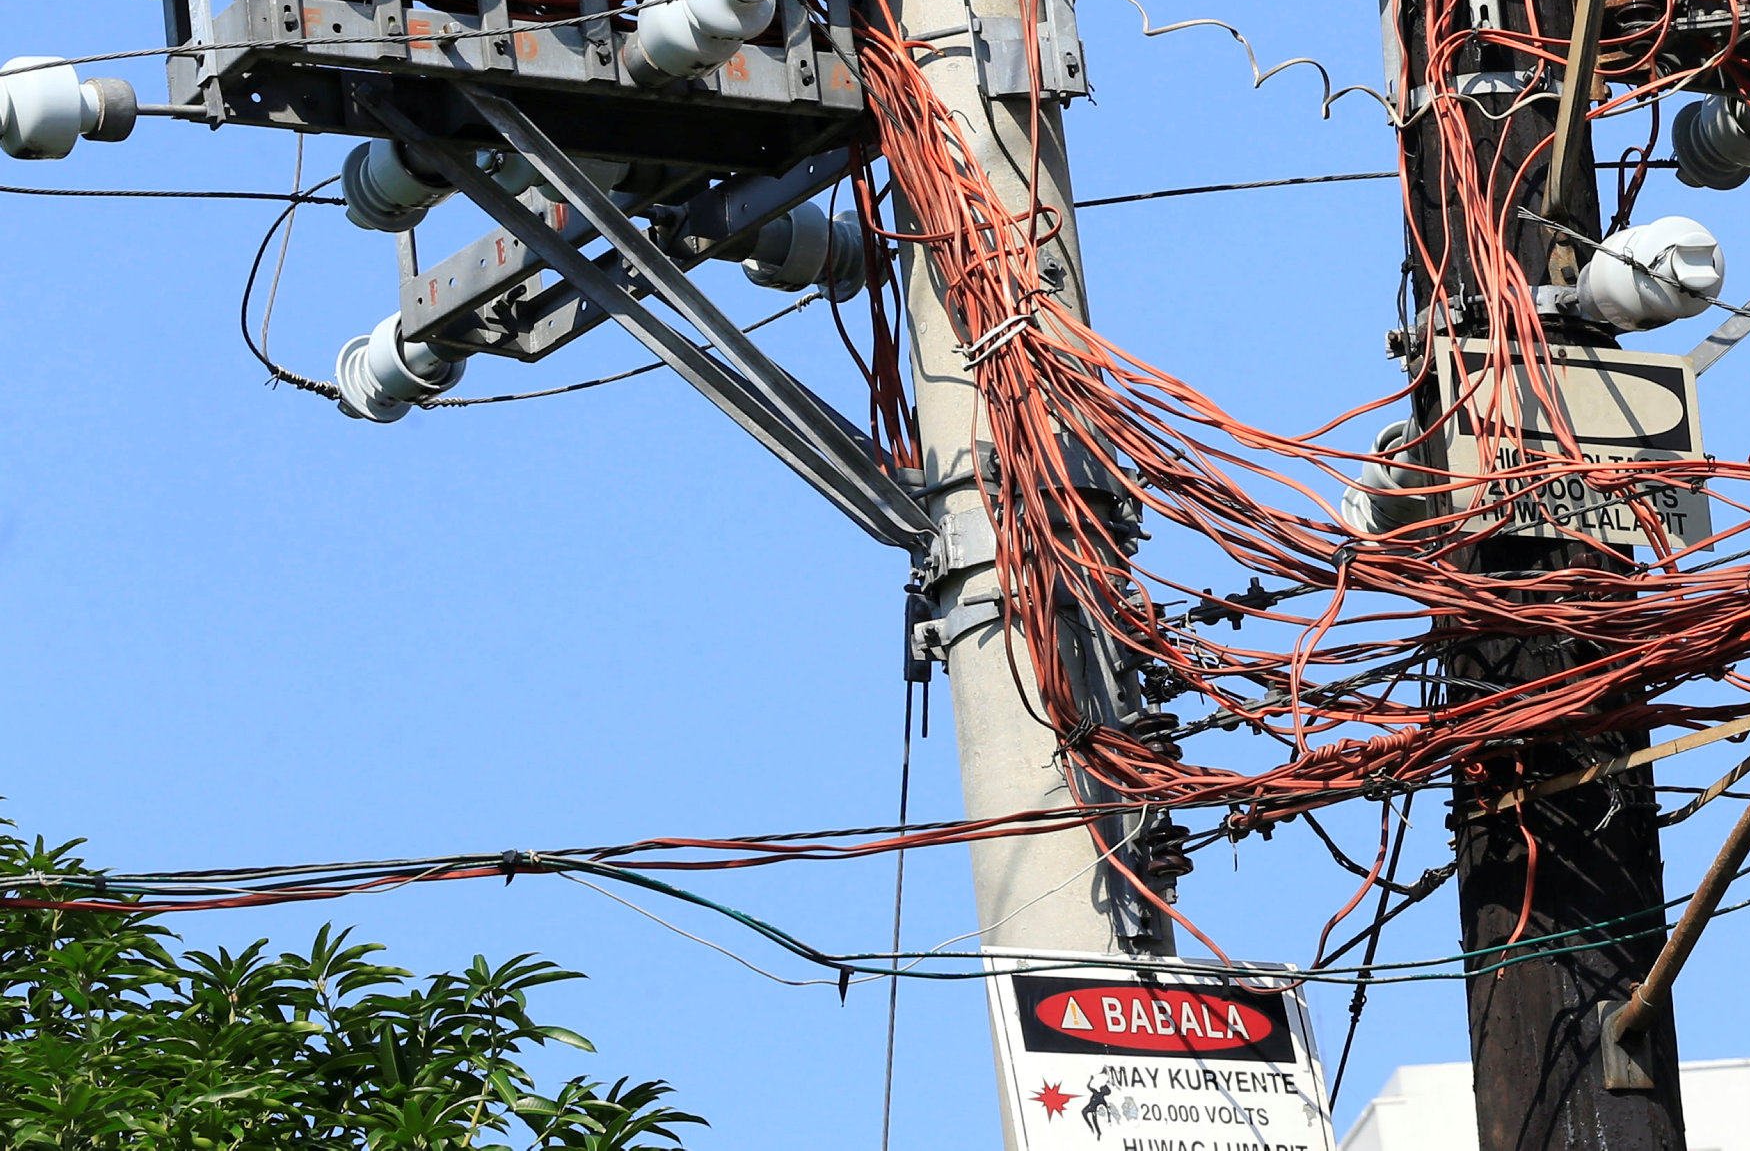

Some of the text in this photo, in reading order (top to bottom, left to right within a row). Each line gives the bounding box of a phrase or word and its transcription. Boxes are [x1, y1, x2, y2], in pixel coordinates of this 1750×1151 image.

[408, 19, 433, 49] E
[1101, 996, 1250, 1040] BABALA
[1109, 1065, 1299, 1095] MAY KURYENTE
[1140, 1103, 1270, 1126] 20,000 VOLTS
